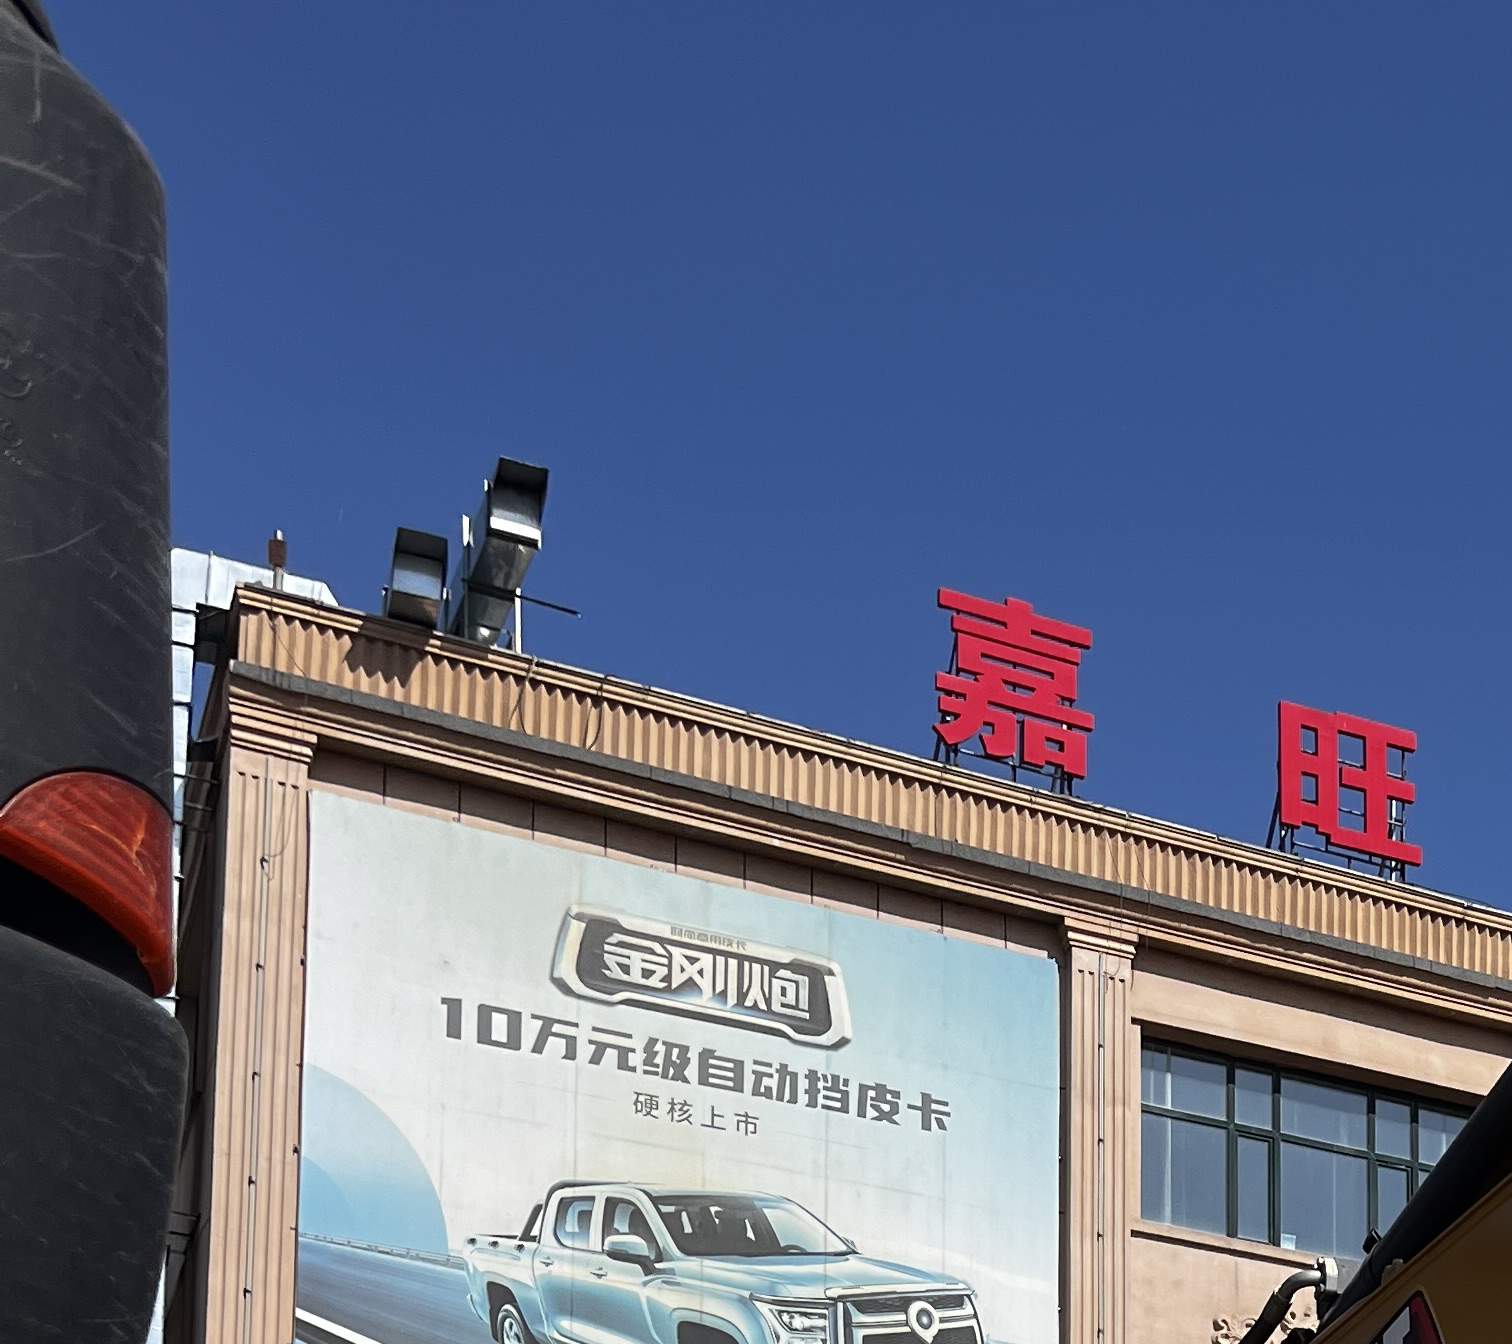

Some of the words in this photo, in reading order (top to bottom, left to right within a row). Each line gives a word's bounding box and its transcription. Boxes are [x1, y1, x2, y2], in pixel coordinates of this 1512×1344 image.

[600, 932, 811, 1020] 金刚炮
[439, 997, 952, 1132] 10万元级自动挡皮卡
[631, 1090, 761, 1138] 硬核上市
